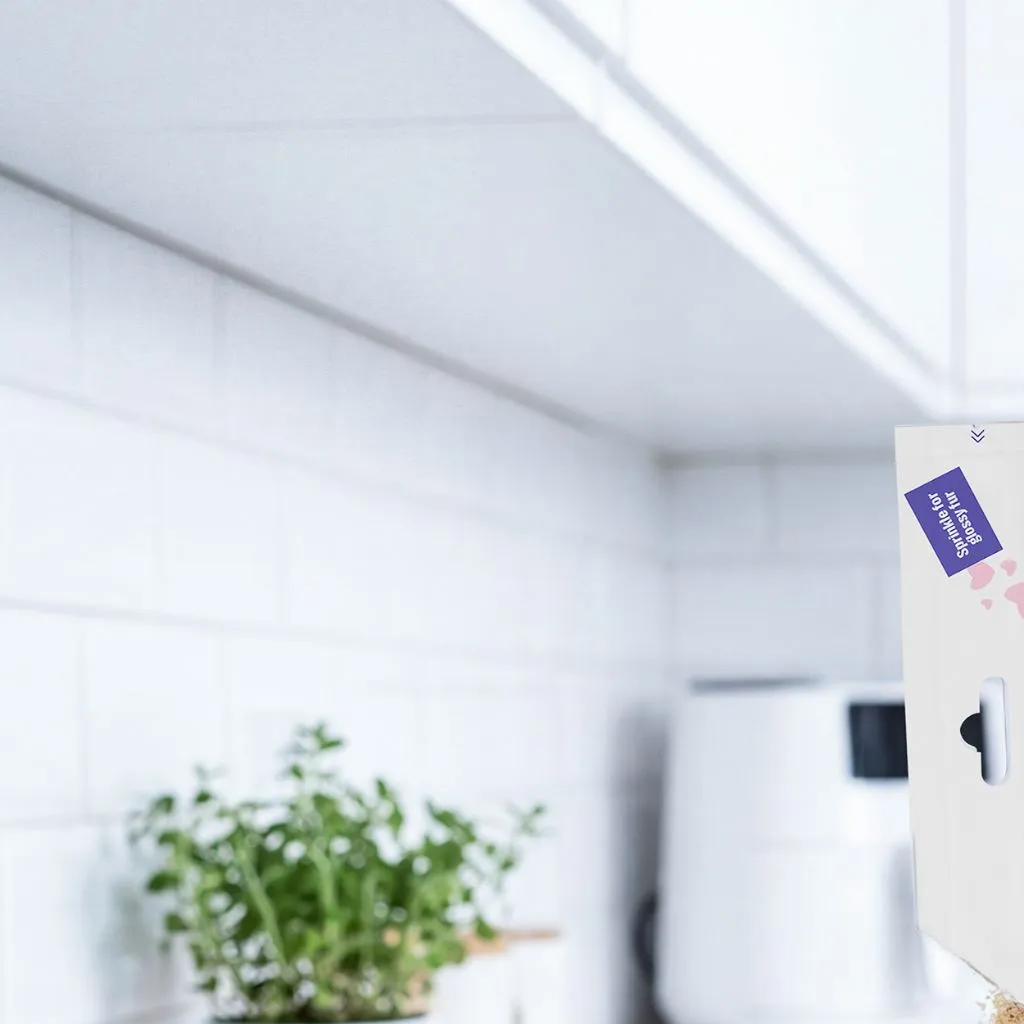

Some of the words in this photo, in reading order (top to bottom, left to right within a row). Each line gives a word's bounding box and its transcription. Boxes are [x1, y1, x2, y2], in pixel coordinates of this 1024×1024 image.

[928, 493, 944, 511] for
[944, 491, 960, 509] fur
[939, 510, 969, 558] Sprinkle
[954, 508, 982, 545] glossy
